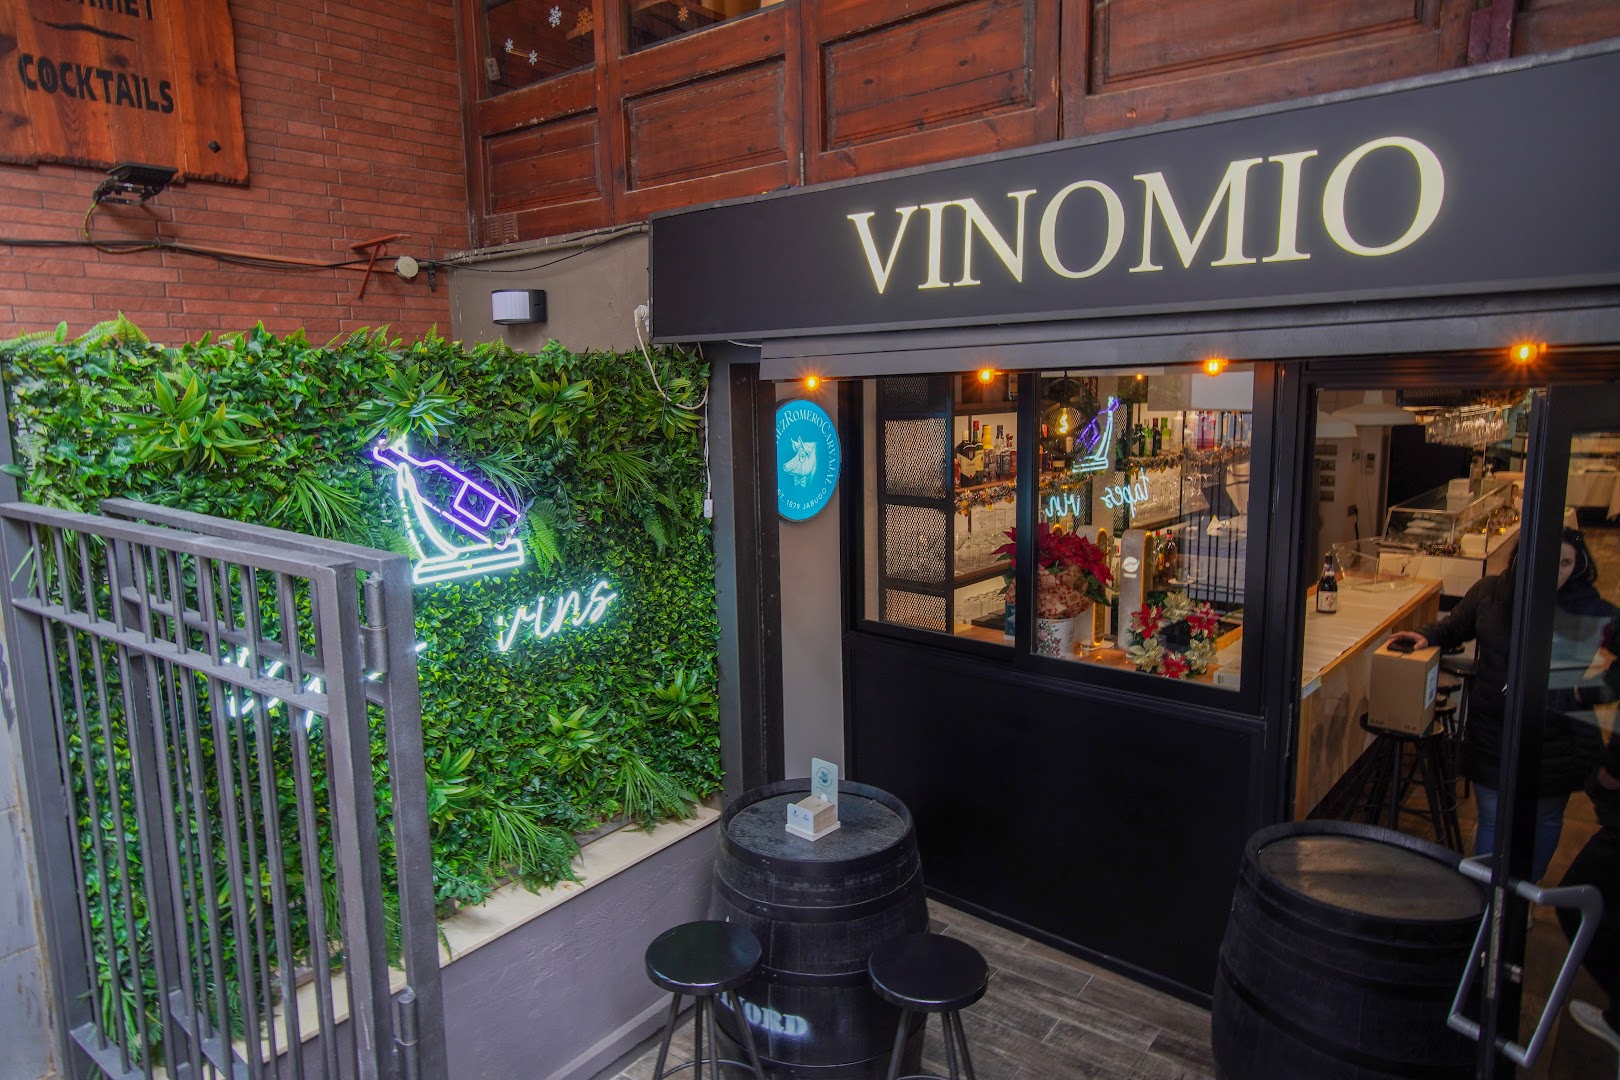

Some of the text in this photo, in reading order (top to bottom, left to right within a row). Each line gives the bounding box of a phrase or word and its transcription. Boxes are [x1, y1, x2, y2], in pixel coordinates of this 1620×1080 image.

[18, 53, 175, 114] COCKTAILS
[847, 136, 1446, 295] VINOMIO
[802, 487, 828, 511] JABUGO
[497, 579, 618, 652] vins
